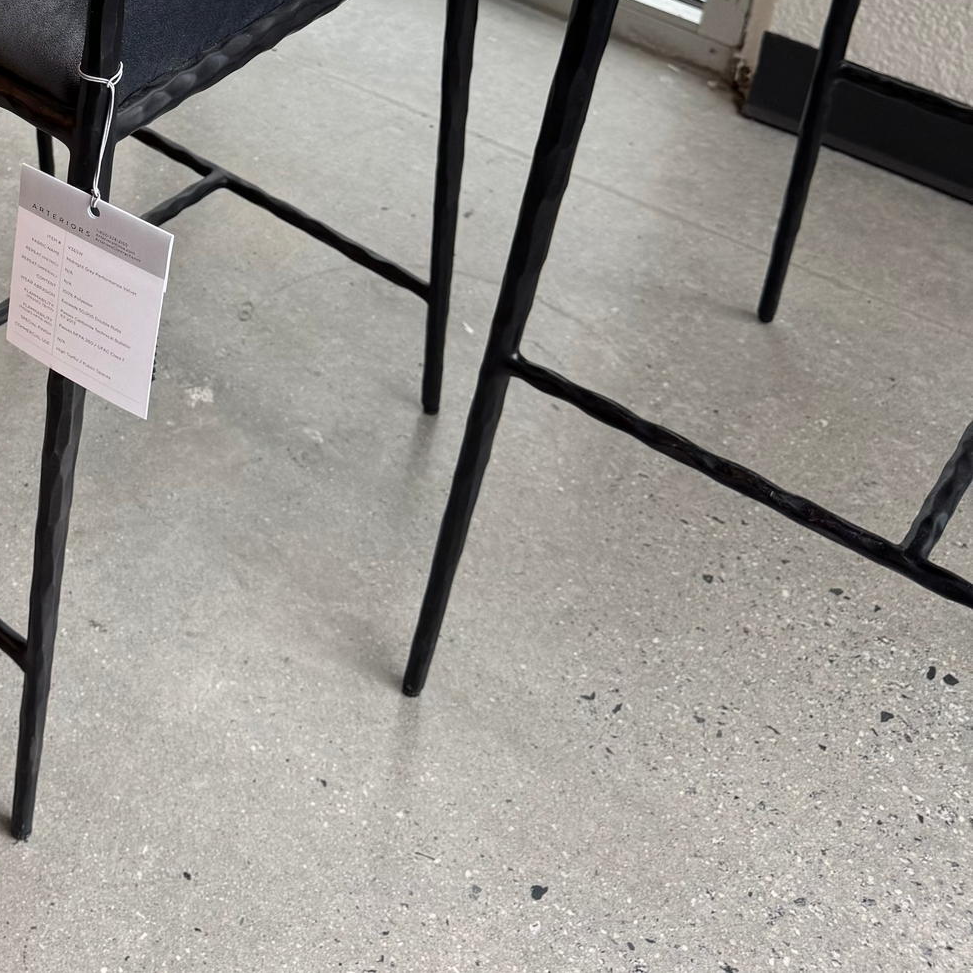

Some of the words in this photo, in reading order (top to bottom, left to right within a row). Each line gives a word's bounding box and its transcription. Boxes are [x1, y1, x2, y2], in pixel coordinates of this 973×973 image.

[32, 203, 91, 237] ARTERIORS
[32, 238, 46, 249] FABRIC
[48, 246, 59, 255] NAME
[47, 234, 57, 242] ITEM
[22, 255, 37, 265] REPEAT
[26, 245, 41, 257] REPEAT
[21, 275, 33, 285] WEAR
[34, 283, 55, 297] ABRASION
[36, 273, 56, 287] CONTENT
[66, 257, 84, 270] Midnight
[85, 266, 95, 276] Grey
[96, 272, 122, 289] Performance
[123, 286, 137, 296] Velvet
[24, 287, 54, 307] FLAMMABILITY
[63, 289, 73, 297] 100%
[74, 295, 93, 308] Polyester
[23, 302, 52, 322] FLAMMABILITY
[62, 298, 78, 310] Exceeds
[95, 317, 109, 327] Double
[111, 325, 121, 334] Rubs
[15, 321, 41, 340] COMMERCIAL
[21, 314, 37, 327] SPECIAL
[38, 325, 51, 336] FINISH
[60, 309, 73, 319] Passes
[75, 316, 94, 330] California
[95, 327, 113, 341] Technical
[114, 338, 131, 350] Bulletin
[59, 323, 72, 333] Passes
[73, 331, 84, 340] NFPA
[97, 345, 109, 355] UFAC
[110, 351, 121, 361] Class
[56, 346, 66, 355] High
[67, 352, 78, 361] Traffic
[83, 361, 95, 371] Public
[96, 369, 111, 380] Spaces
